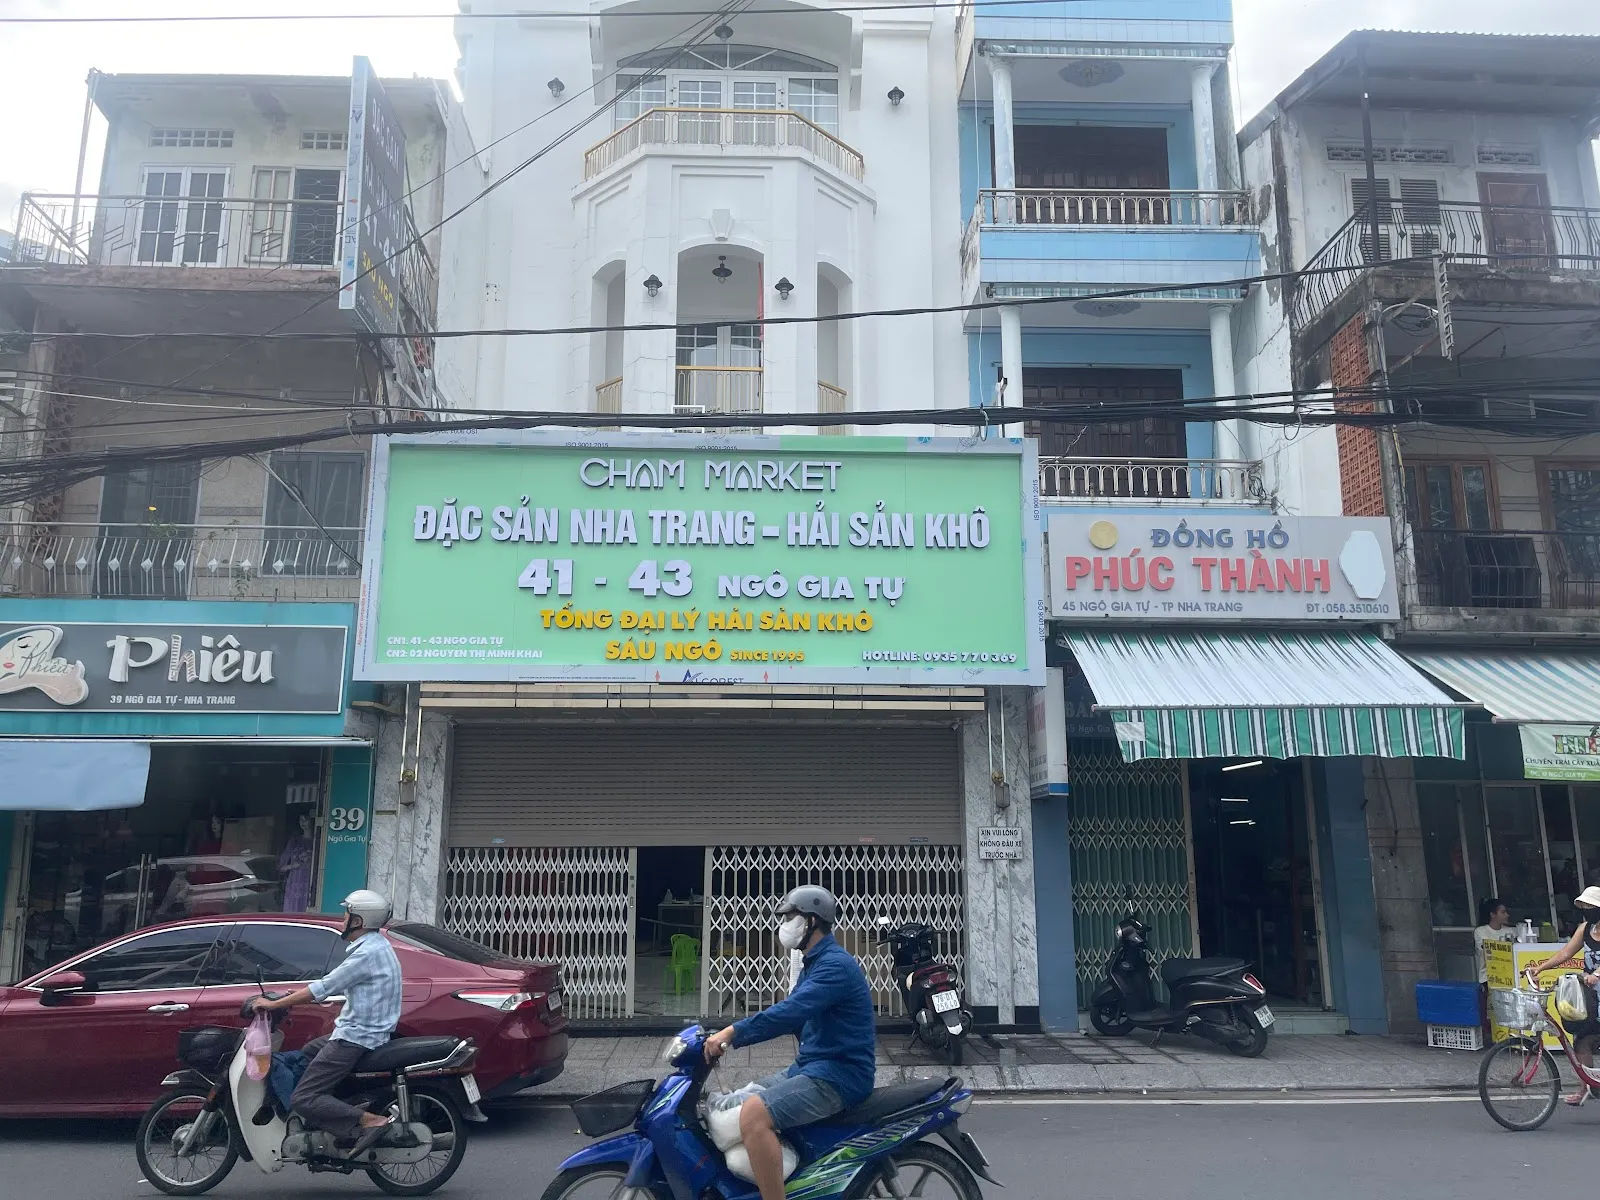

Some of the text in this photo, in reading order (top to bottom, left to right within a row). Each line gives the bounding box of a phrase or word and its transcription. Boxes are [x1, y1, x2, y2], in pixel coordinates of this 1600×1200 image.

[579, 458, 842, 491] CHAM MARKET
[413, 497, 484, 547] ĐẶC
[490, 494, 559, 543] SẢN
[570, 509, 638, 545] NHA
[648, 510, 755, 546] TRANG
[787, 500, 840, 547] HẢI
[849, 499, 915, 548] SẢN
[925, 505, 990, 549] KHÔ
[1150, 518, 1290, 549] ĐỒNG HỒ
[518, 558, 575, 596] 41
[628, 560, 693, 598] 43
[718, 569, 789, 599] NGÔ
[797, 576, 855, 600] GIA
[864, 576, 906, 607] TỰ
[1065, 548, 1332, 593] PHÚC THÀNH
[540, 602, 874, 634] TỔNG ĐẠI LÝ HẢI SẢN KHÔ
[1062, 601, 1076, 611] 45
[1080, 599, 1107, 611] NGÔ
[1111, 601, 1133, 612] GIA
[1136, 600, 1151, 613] TỰ
[1162, 602, 1174, 612] TP
[1178, 602, 1201, 612] NHA
[1204, 602, 1243, 612] TRANG
[410, 636, 421, 645] 41
[428, 636, 442, 645] 43
[469, 636, 488, 645] GIA
[605, 636, 805, 662] SÁU NGÔ SINCE 1995
[106, 634, 276, 684] Phiêu
[409, 650, 423, 658] 02
[486, 650, 516, 659] MINH
[516, 650, 543, 659] KHAI
[862, 650, 1017, 663] HOTLINE: 0935 770 369
[110, 695, 123, 704] 39
[125, 693, 144, 704] NGÔ
[146, 695, 162, 704] GIA
[165, 694, 178, 706] TỰ
[184, 695, 203, 705] NHA
[206, 695, 236, 705] TRANG
[330, 807, 365, 831] 39
[980, 839, 1001, 847] KHÔNG
[1015, 840, 1022, 848] XE
